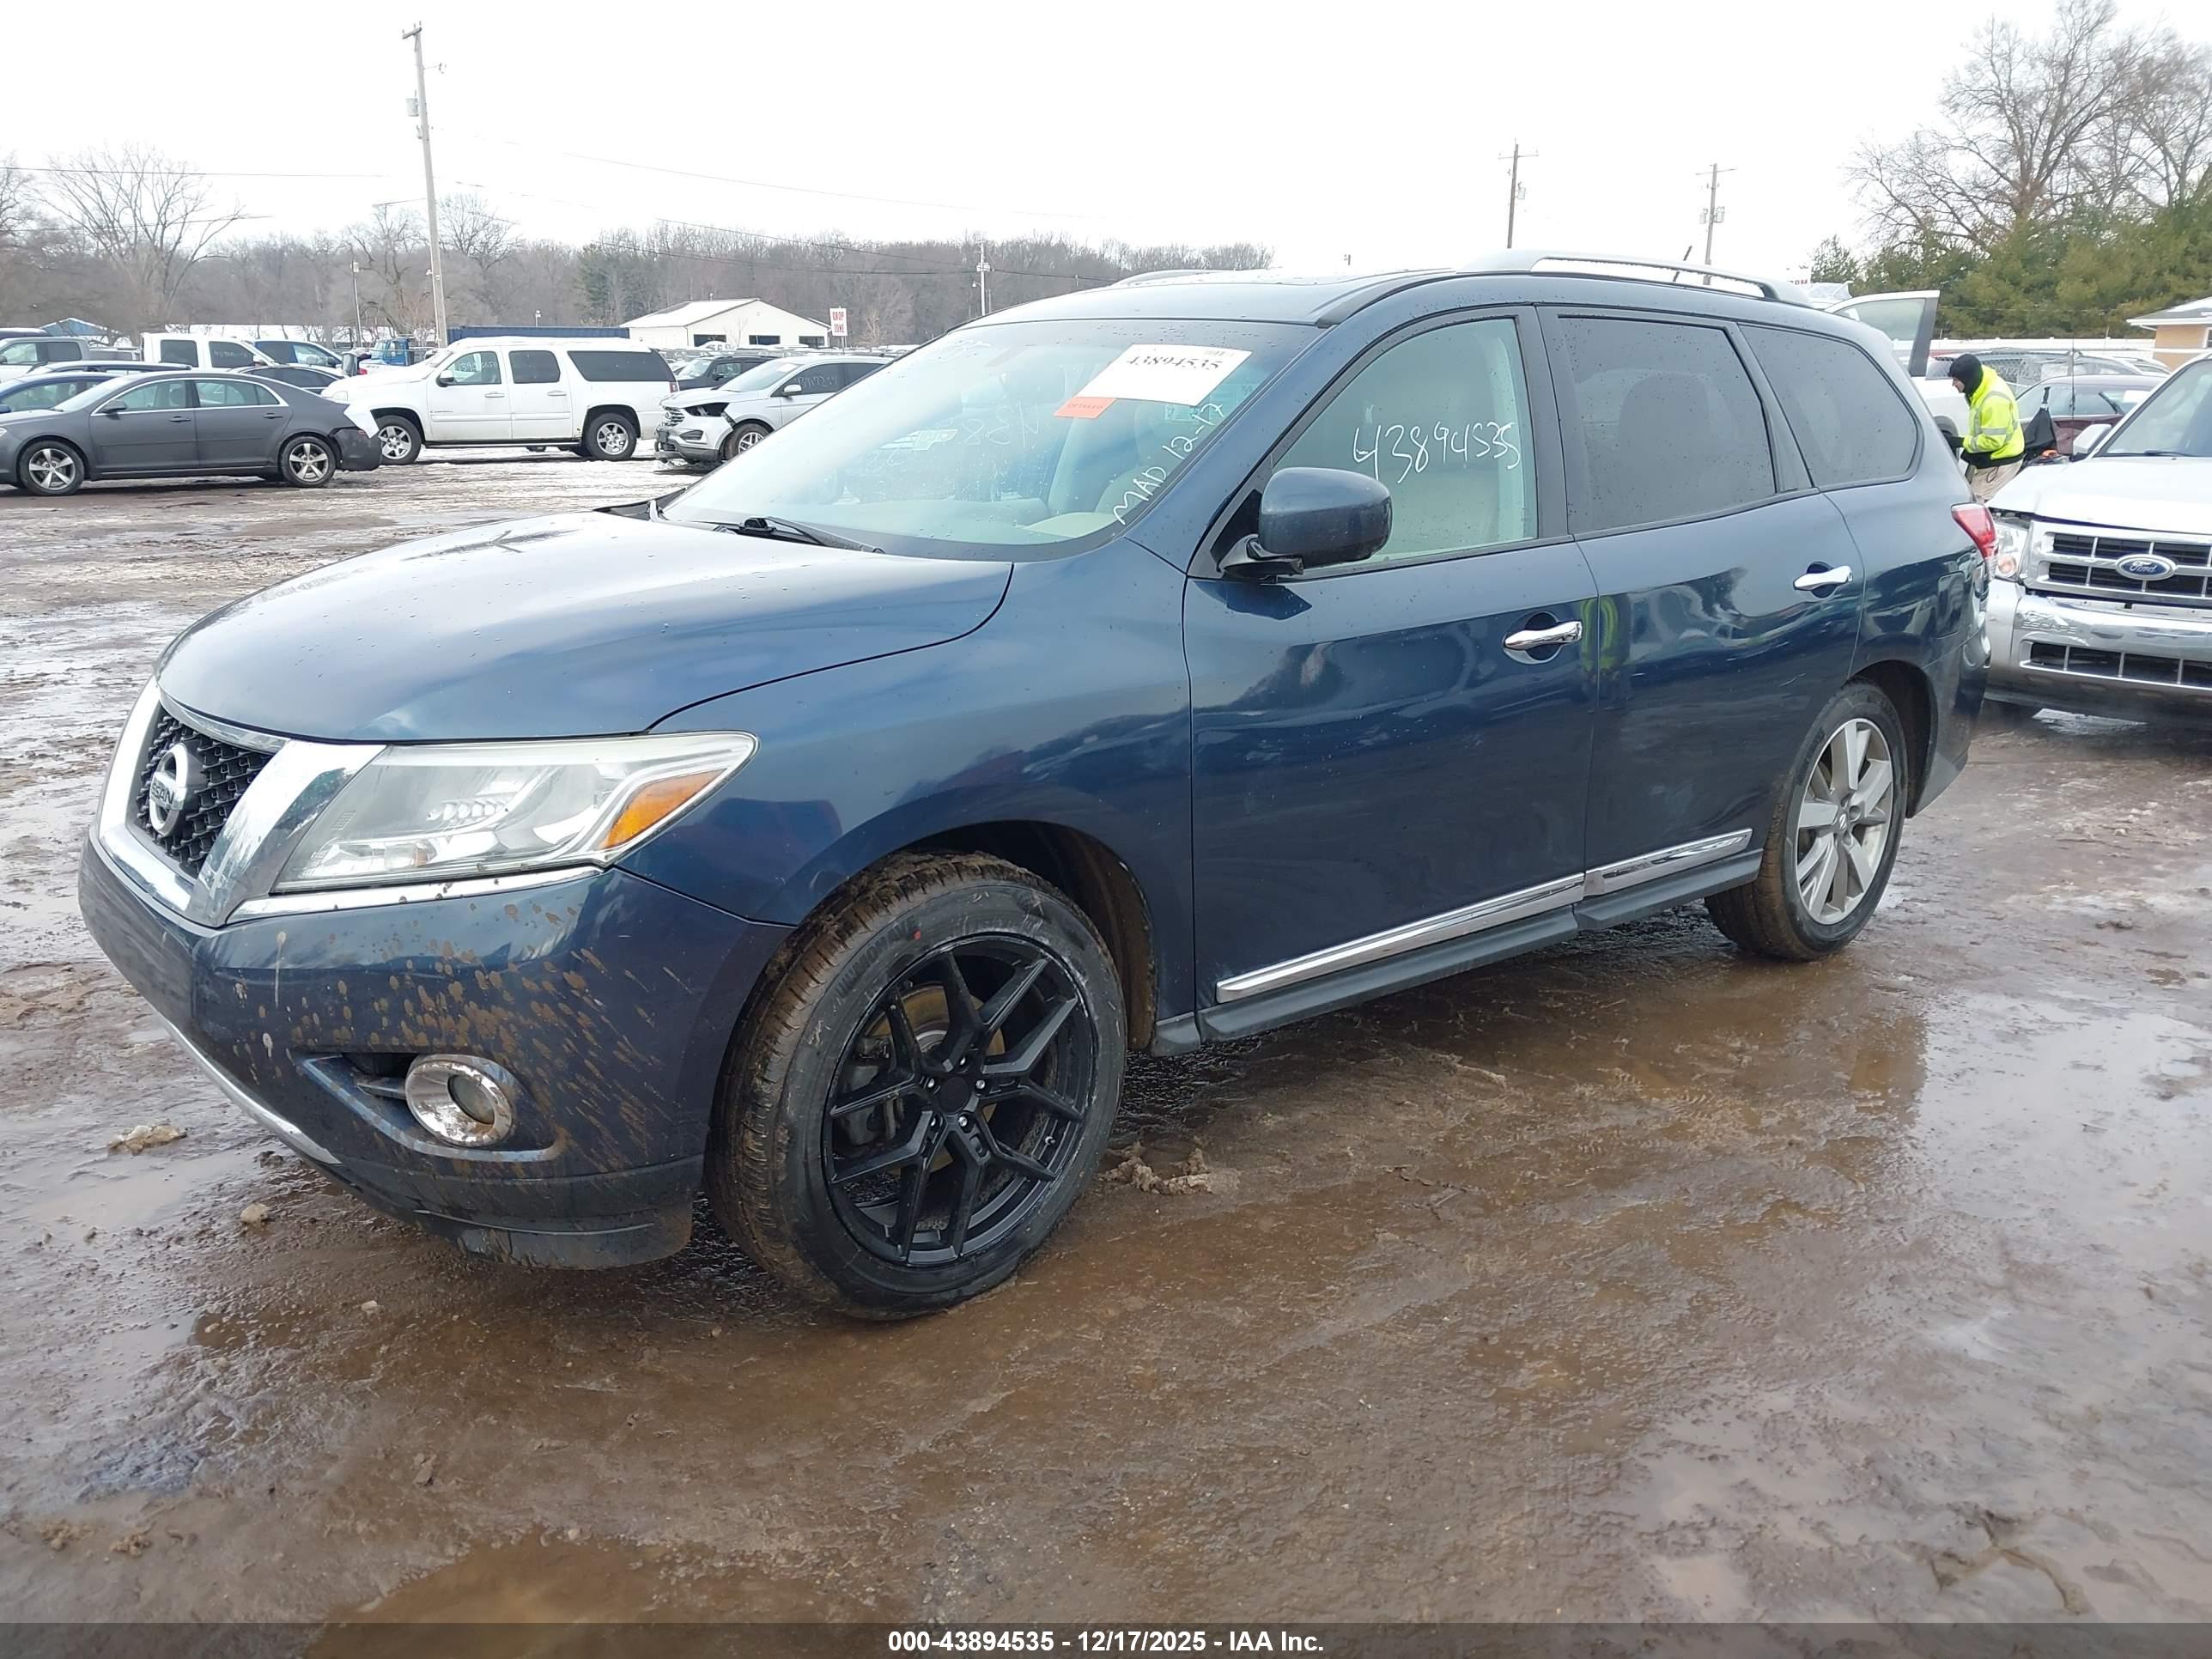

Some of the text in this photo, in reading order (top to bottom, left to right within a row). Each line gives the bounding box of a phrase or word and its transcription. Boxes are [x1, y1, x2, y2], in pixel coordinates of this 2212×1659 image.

[1126, 356, 1224, 371] 43894535
[1352, 421, 1521, 484] 43894535
[1113, 466, 1167, 526] MAD
[2129, 561, 2158, 574] Ford
